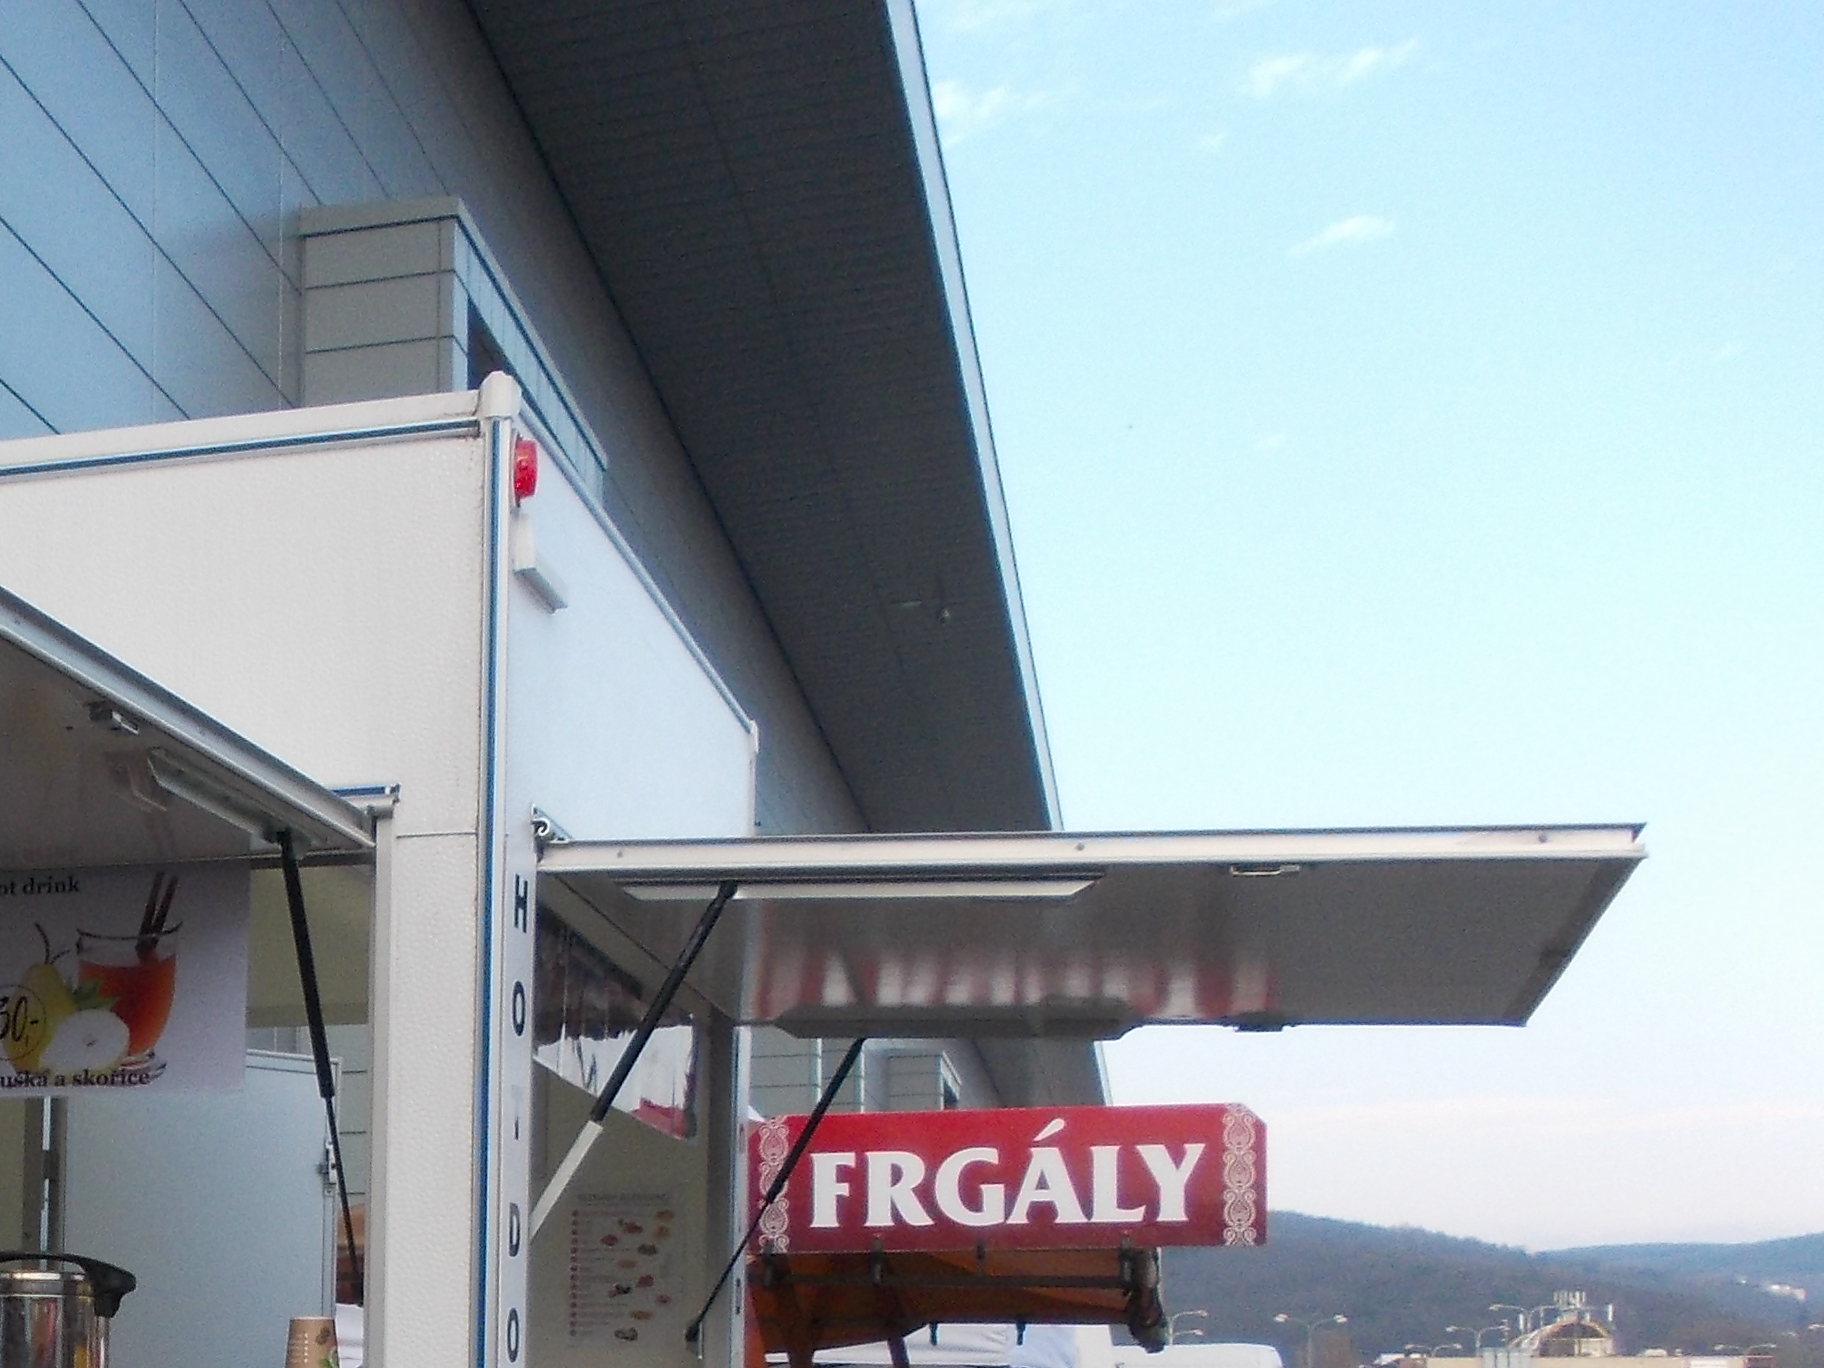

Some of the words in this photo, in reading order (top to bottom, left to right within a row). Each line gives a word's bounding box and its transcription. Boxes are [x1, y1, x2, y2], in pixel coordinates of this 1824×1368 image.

[22, 876, 80, 896] drink
[53, 1074, 67, 1087] a
[809, 1118, 1206, 1228] FRGÁLY
